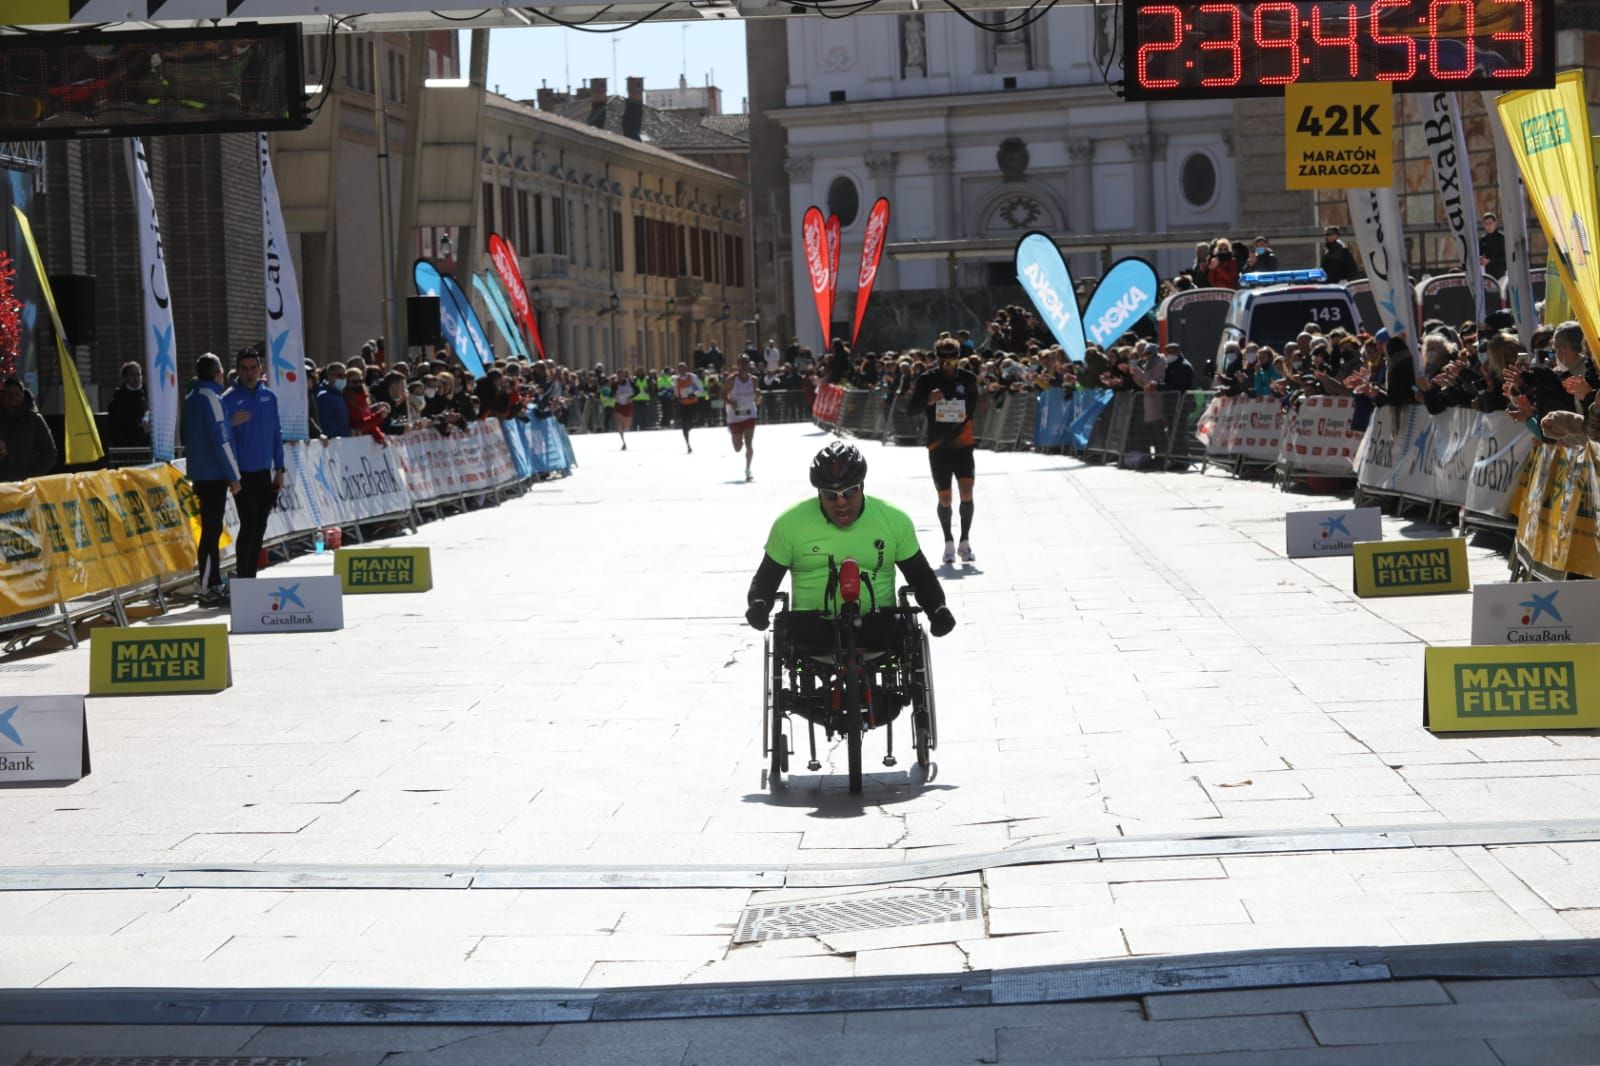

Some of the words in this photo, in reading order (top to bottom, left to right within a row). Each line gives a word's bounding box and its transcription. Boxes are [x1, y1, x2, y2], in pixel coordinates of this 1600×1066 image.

[1296, 104, 1382, 137] 42K
[1303, 146, 1377, 162] MARATÓN
[1298, 164, 1381, 177] ZARAGOZA
[1089, 285, 1149, 345] HOKA
[1310, 306, 1342, 322] 143
[328, 453, 402, 503] CaixaBank
[352, 557, 411, 571] MANN
[1378, 551, 1447, 571] MANN
[352, 570, 411, 584] FILTER
[1378, 567, 1448, 585] FILTER
[261, 614, 314, 627] CaixaBank
[1506, 629, 1572, 643] CaixaBank
[116, 642, 201, 662] MANN
[116, 660, 201, 680] FILTER
[1460, 666, 1568, 690] MANN
[1463, 688, 1571, 712] FILTER
